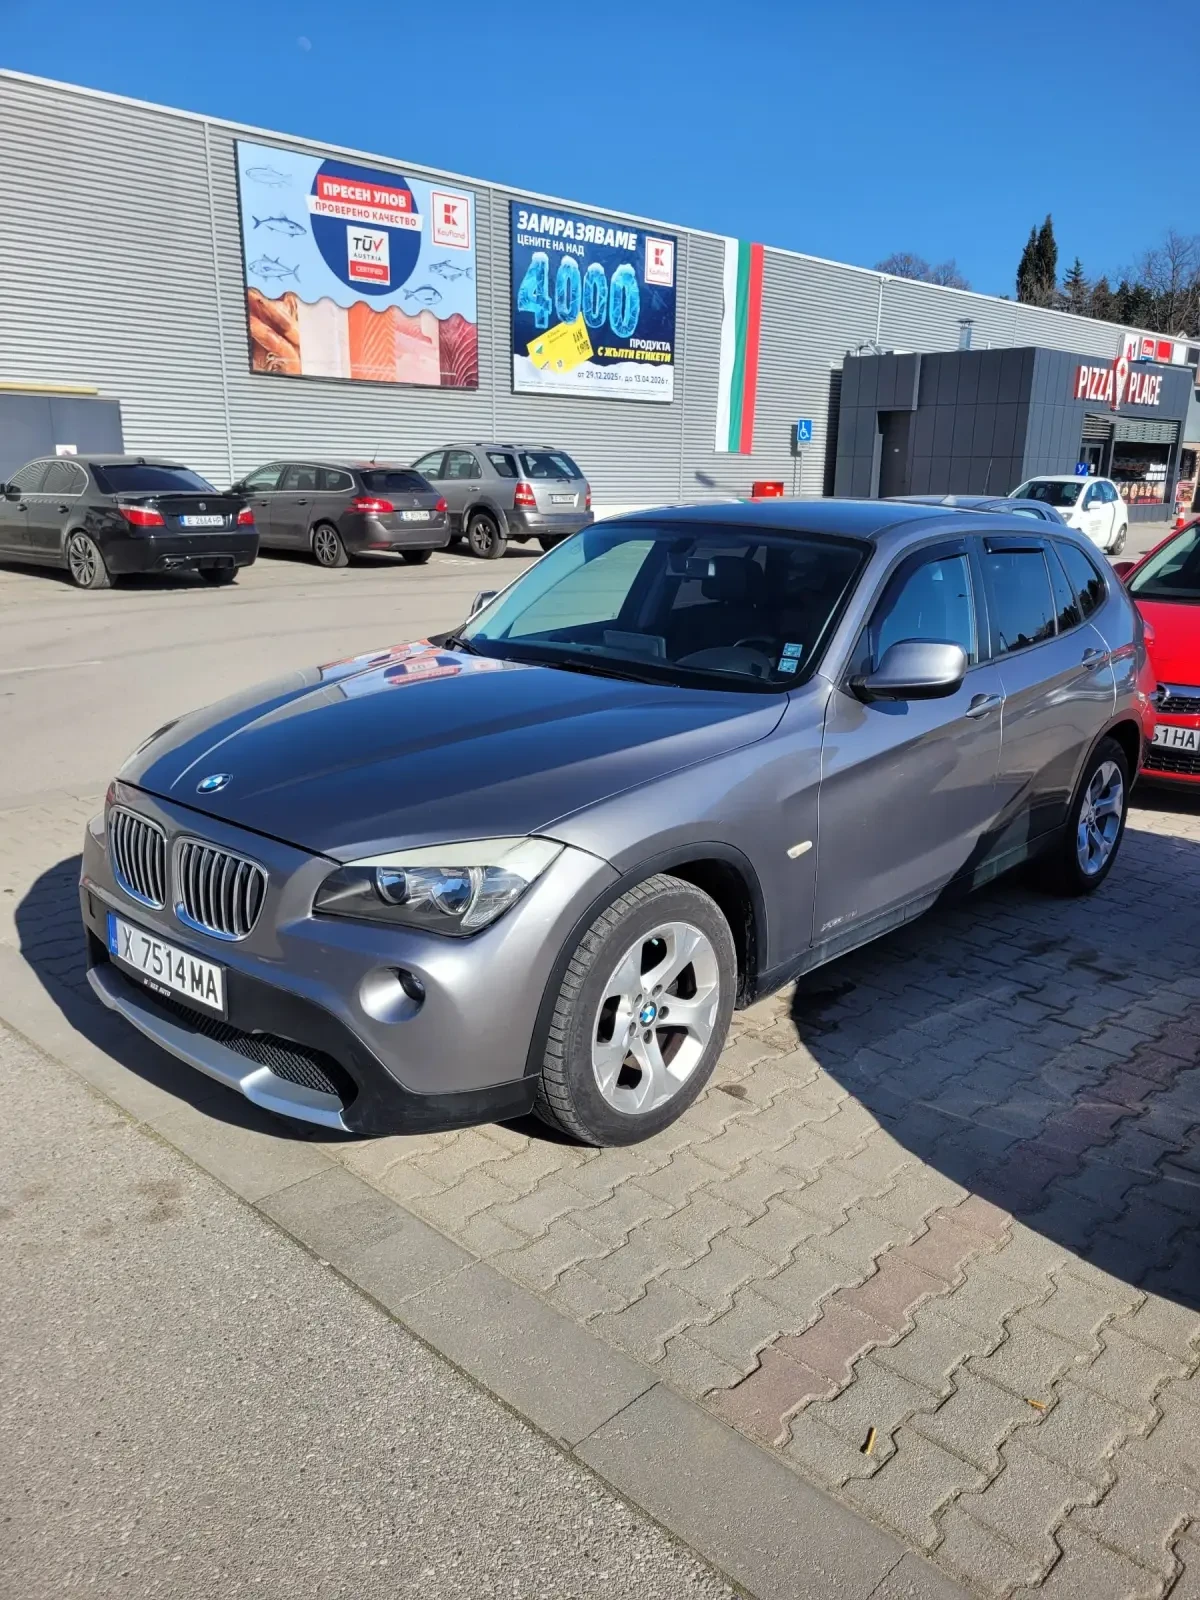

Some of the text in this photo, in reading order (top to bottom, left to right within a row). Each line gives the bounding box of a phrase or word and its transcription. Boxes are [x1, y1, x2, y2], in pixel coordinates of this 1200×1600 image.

[323, 182, 407, 208] ПРЕСЕН УЛОВ
[315, 201, 417, 227] ПРОВЕРЕНО КАЧЕСТВО
[437, 228, 466, 240] Kaufland
[516, 210, 638, 251] ЗАМРАЗЯВАМЕ
[353, 252, 382, 262] AUSTRIA
[517, 233, 585, 257] ЦЕНИТЕ НА НАД
[517, 251, 641, 338] 4000
[597, 346, 604, 356] С
[604, 347, 635, 359] ЖЪЛТИ
[635, 350, 671, 362] ЕТИКЕТИ
[629, 338, 671, 352] ПРОДУКТА
[1077, 365, 1163, 405] PIZZA PLACE
[122, 925, 135, 962] X
